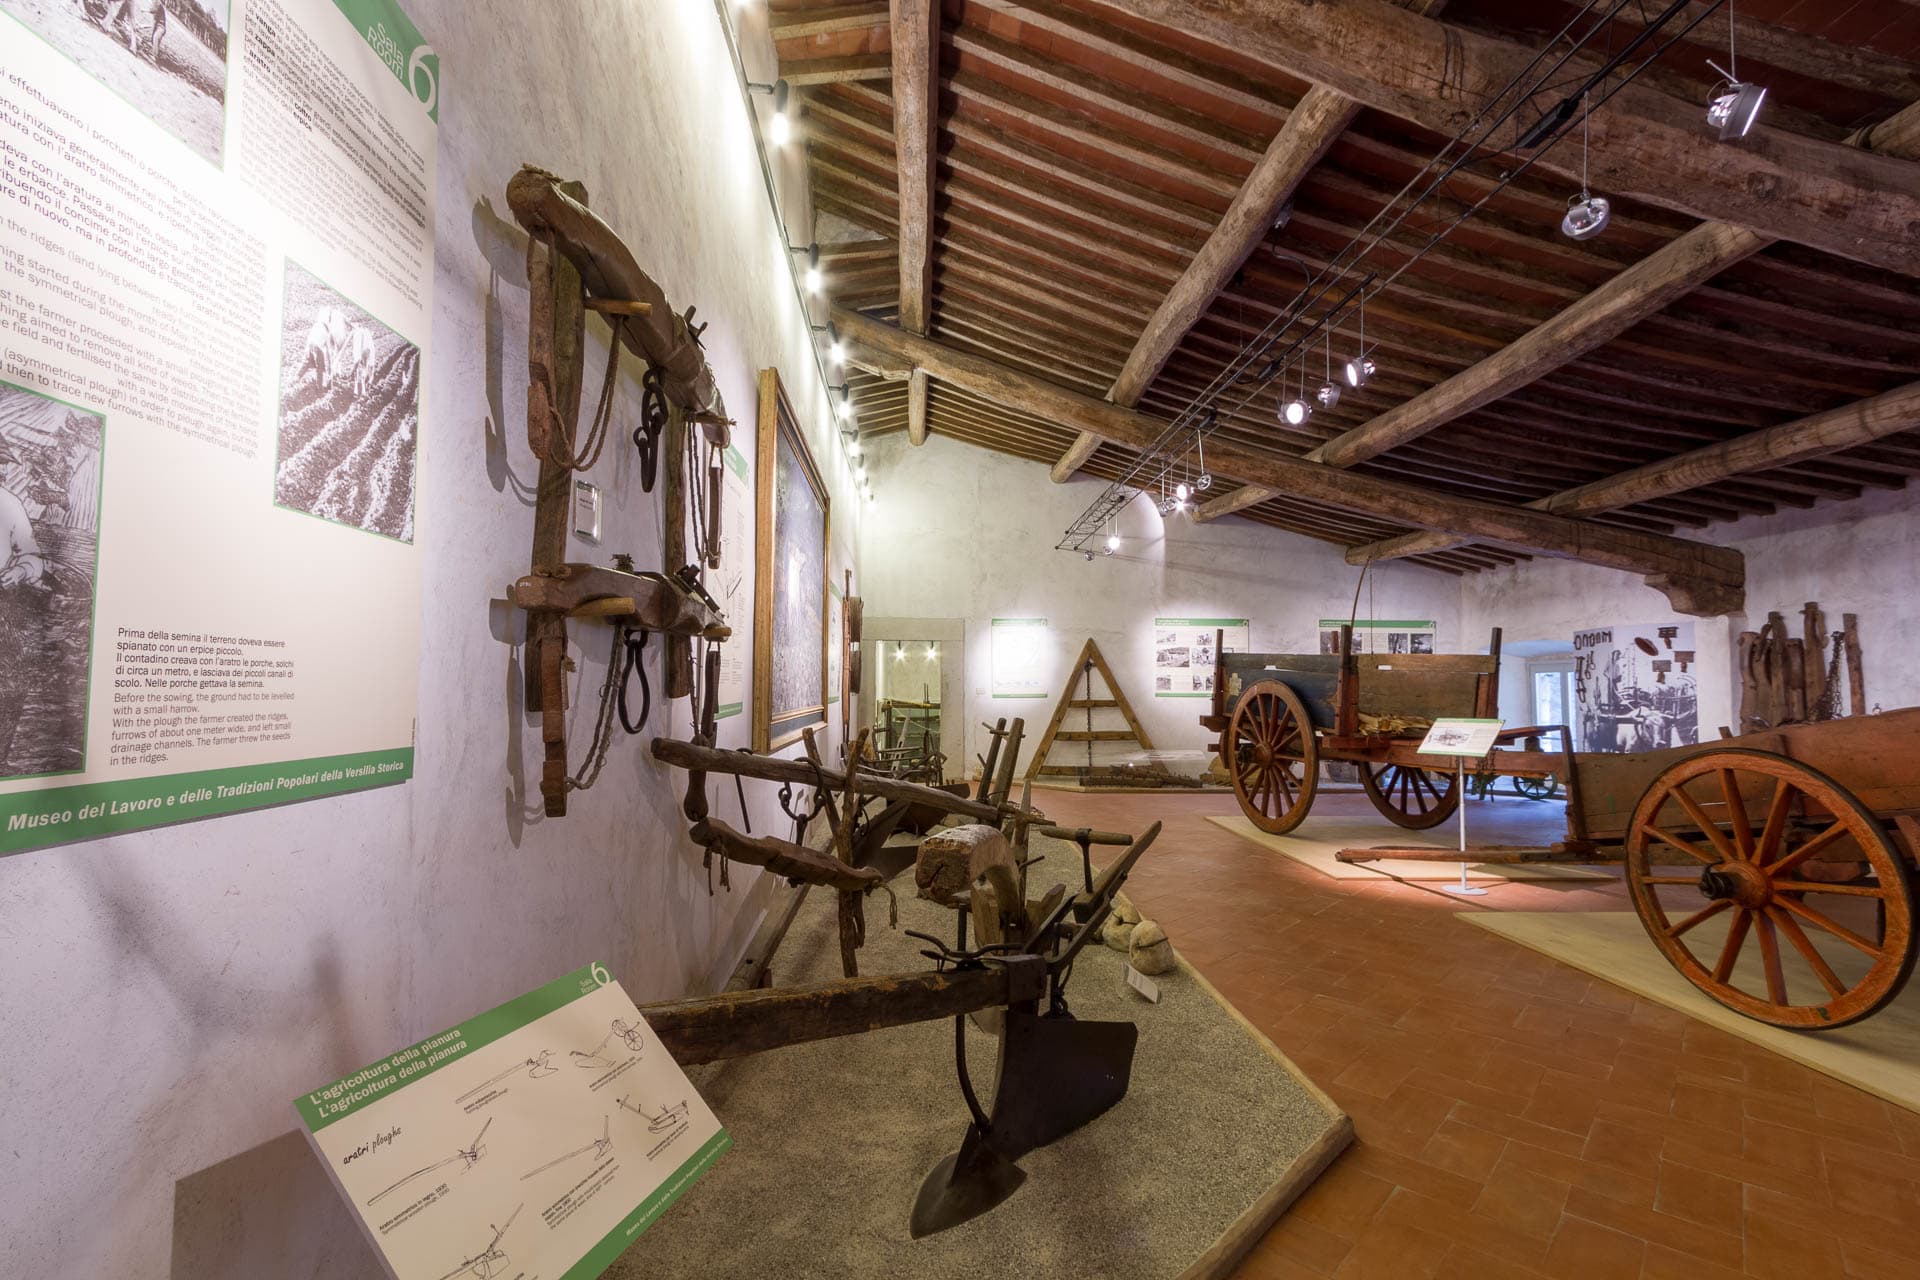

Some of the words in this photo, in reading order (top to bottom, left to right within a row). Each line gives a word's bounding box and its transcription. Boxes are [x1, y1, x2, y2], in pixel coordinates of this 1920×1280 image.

[366, 26, 403, 80] Room
[378, 22, 403, 65] Sala
[408, 45, 436, 113] 6
[9, 76, 83, 130] effettuavano
[23, 109, 66, 145] iniziava
[33, 133, 53, 151] con
[57, 144, 96, 176] l'aratro
[4, 155, 15, 170] le
[19, 167, 69, 201] erbacce.
[73, 195, 115, 227] Passava
[31, 160, 52, 178] con
[56, 171, 103, 207] l'aratura
[19, 192, 30, 207] di
[34, 203, 71, 232] nuovo,
[76, 226, 92, 240] ma
[95, 233, 104, 246] in
[55, 197, 61, 210] il
[63, 205, 109, 236] concime
[112, 232, 129, 247] con
[7, 219, 27, 237] the
[30, 231, 64, 255] ridges
[67, 248, 95, 270] (land
[4, 261, 24, 278] the
[28, 274, 96, 311] symmetrical
[27, 260, 69, 285] started
[72, 278, 105, 305] during
[108, 297, 124, 311] the
[15, 295, 34, 311] the
[38, 303, 76, 329] farmer
[80, 324, 133, 352] proceeded
[30, 317, 66, 338] aimed
[69, 332, 80, 344] to
[83, 339, 120, 360] remove
[12, 321, 38, 341] field
[41, 336, 63, 350] and
[66, 343, 110, 369] fertilised
[113, 363, 129, 376] the
[4, 346, 86, 386] (asymmetrical
[89, 380, 126, 403] plough)
[129, 392, 137, 404] in
[6, 363, 34, 380] then
[37, 374, 49, 386] to
[53, 379, 80, 396] trace
[84, 392, 104, 404] new
[107, 397, 143, 418] furrows
[117, 378, 136, 391] with
[117, 641, 157, 652] spianato
[191, 645, 214, 656] erpice
[216, 646, 243, 656] piccolo.
[118, 628, 144, 638] Prima
[147, 630, 168, 640] della
[169, 633, 200, 642] semina
[203, 634, 207, 642] il
[209, 636, 236, 644] terreno
[237, 637, 262, 646] doveva
[115, 665, 124, 674] di
[126, 666, 148, 675] circa
[165, 668, 191, 678] metro,
[200, 668, 230, 676] lasciava
[232, 668, 241, 676] dei
[244, 669, 266, 678] piccoli
[124, 654, 168, 663] contadino
[215, 657, 240, 666] l'aratro
[242, 658, 248, 666] le
[114, 678, 142, 687] scolo.
[145, 678, 167, 687] Nelle
[169, 679, 197, 689] porche
[199, 680, 227, 689] gettava
[229, 679, 236, 687] la
[114, 693, 144, 702] Before
[147, 693, 161, 702] the
[163, 693, 193, 703] sowing,
[195, 693, 208, 701] the
[210, 692, 236, 703] ground
[238, 692, 251, 700] had
[261, 692, 269, 700] be
[113, 718, 133, 727] With
[136, 717, 151, 726] the
[153, 716, 182, 728] plough
[184, 715, 197, 724] the
[199, 715, 224, 723] farmer
[226, 713, 253, 722] created
[255, 713, 266, 721] the
[114, 705, 132, 714] with
[143, 704, 168, 714] small
[170, 704, 199, 713] harrow.
[111, 731, 146, 740] furrows
[148, 729, 157, 738] of
[159, 728, 184, 737] about
[228, 724, 246, 734] wide,
[247, 723, 260, 731] and
[111, 743, 151, 753] drainage
[153, 739, 194, 750] channels.
[197, 738, 210, 746] The
[212, 737, 237, 745] farmer
[239, 735, 257, 743] threw
[271, 732, 291, 740] seeds
[110, 757, 118, 766] in
[121, 755, 136, 765] the
[139, 754, 168, 765] ridges.
[8, 811, 71, 830] Museo
[78, 802, 105, 820] del
[111, 798, 160, 814] Lavoro
[166, 796, 174, 806] e
[180, 788, 212, 804] delle
[217, 779, 273, 798] Tradizioni
[277, 772, 318, 789] Popolari
[321, 769, 343, 782] della
[345, 765, 375, 778] Versilia
[377, 761, 404, 773] Storica
[591, 961, 610, 987] 6
[310, 1063, 390, 1104] L'agricoltura
[390, 1049, 420, 1066] della
[422, 1030, 461, 1054] pianura
[318, 1075, 398, 1117] L'agricoltura
[397, 1061, 426, 1078] della
[428, 1041, 467, 1066] pianura
[342, 1143, 370, 1164] aratri
[369, 1127, 403, 1153] ploughs
